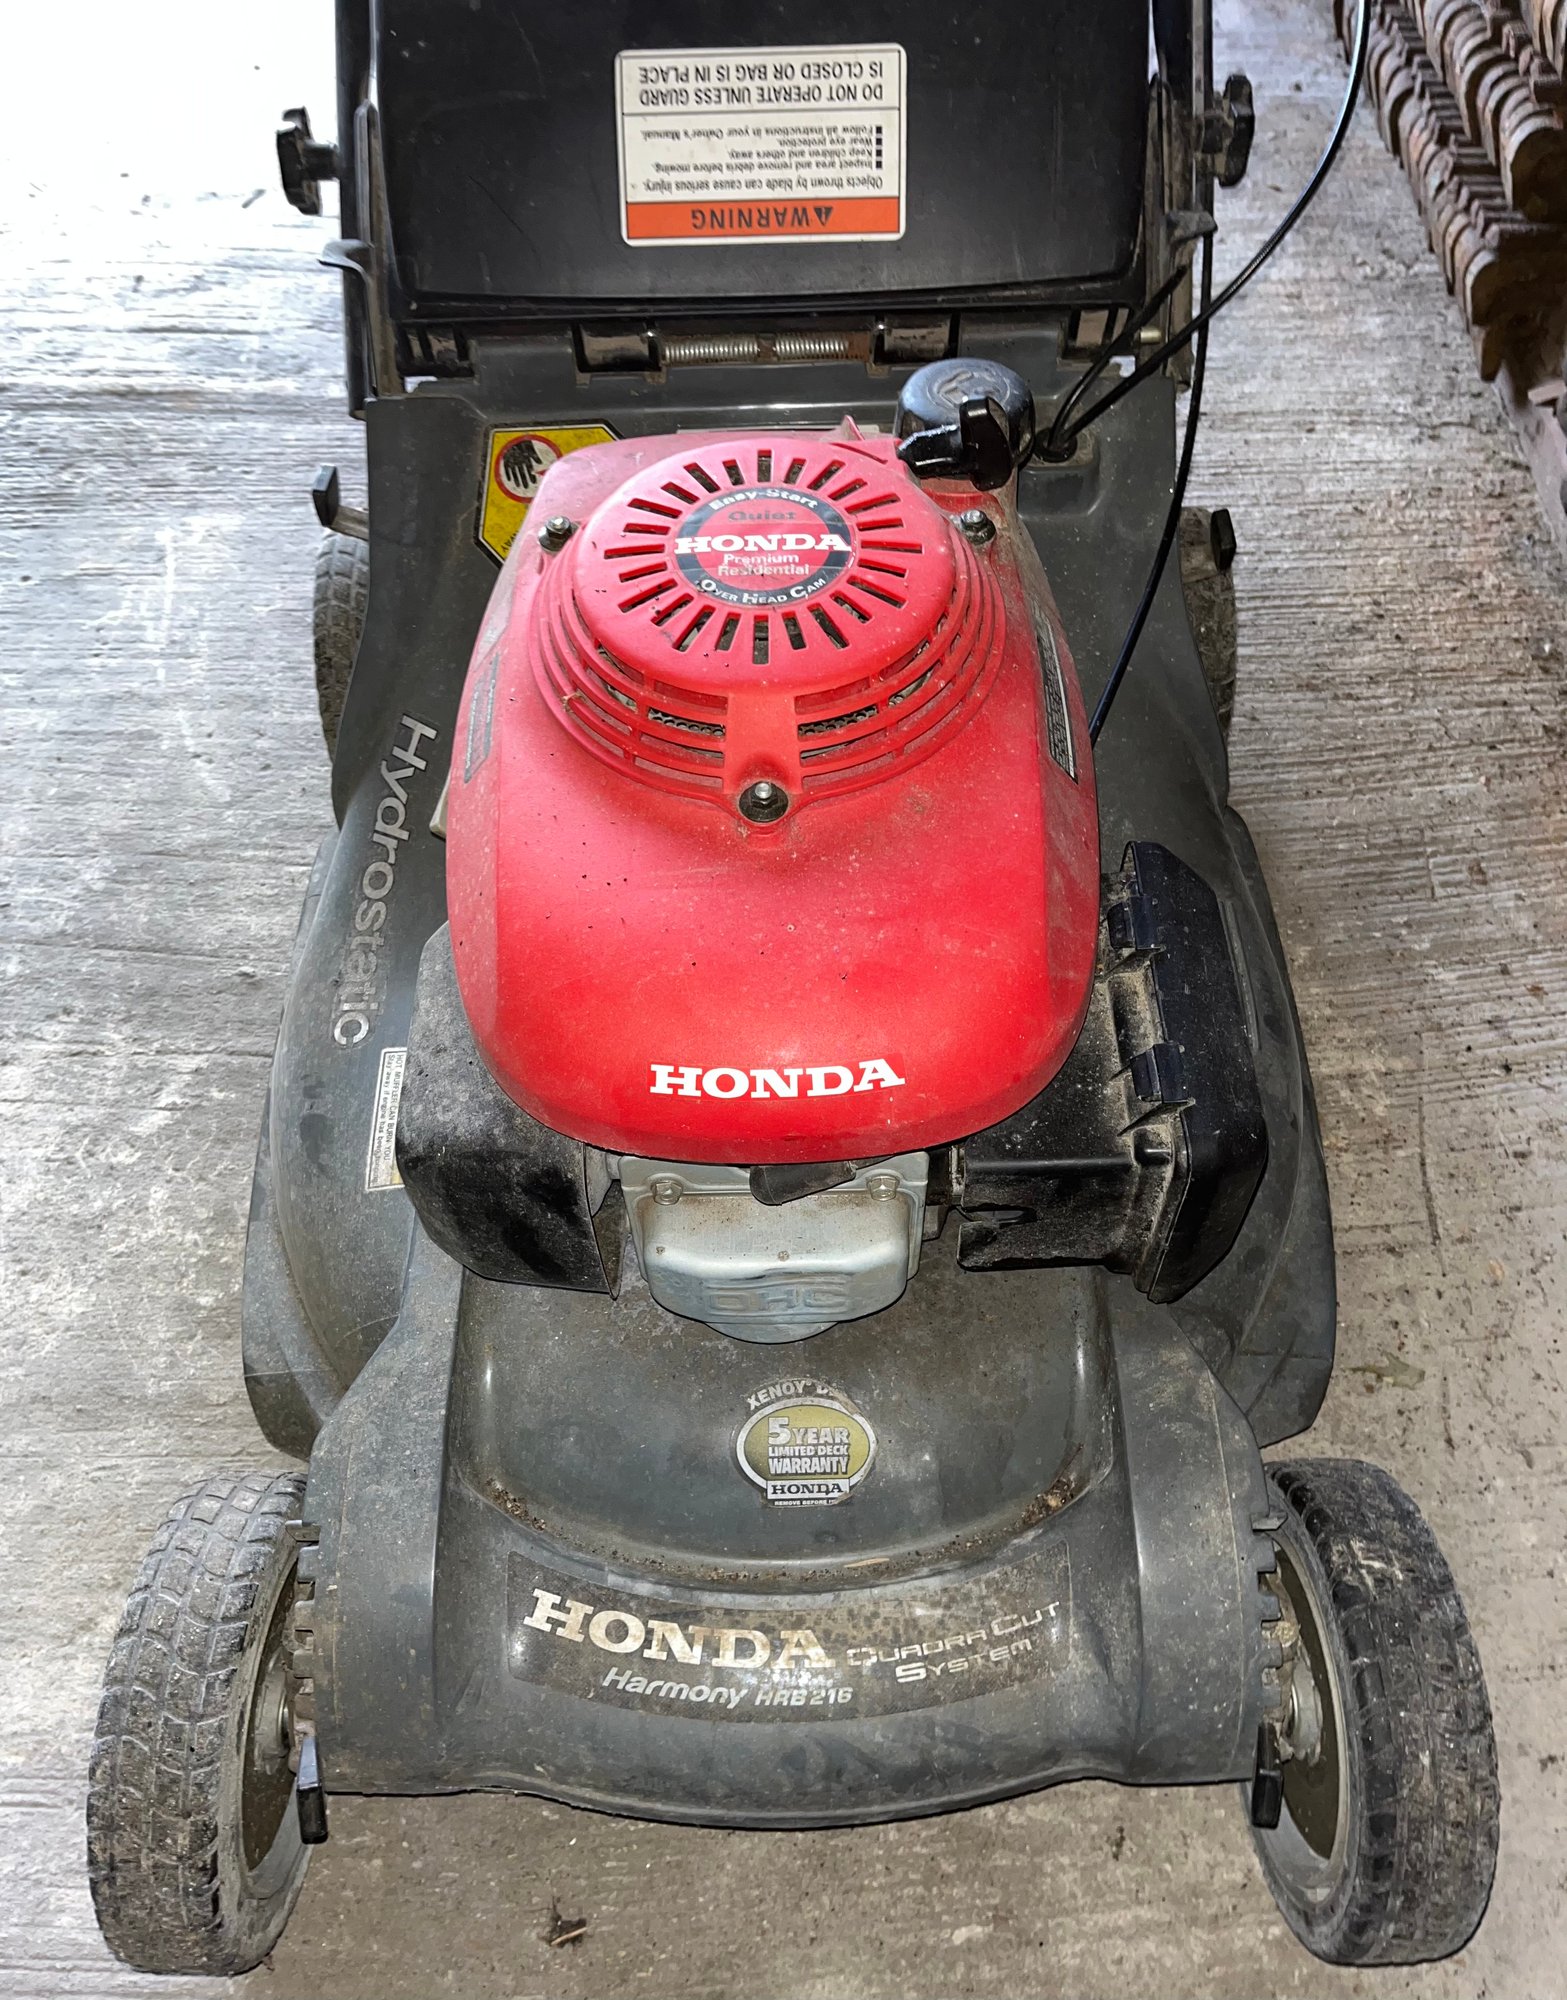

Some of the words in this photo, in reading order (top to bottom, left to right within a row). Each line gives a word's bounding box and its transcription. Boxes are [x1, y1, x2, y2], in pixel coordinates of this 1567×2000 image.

[638, 66, 689, 84] PLACE
[695, 66, 711, 82] IN
[716, 66, 730, 82] IS
[734, 64, 767, 81] BAG
[773, 62, 795, 81] OR
[801, 61, 863, 80] CLOSED
[869, 60, 883, 77] IS
[639, 89, 690, 106] GUARD
[694, 87, 751, 105] UNLESS
[756, 86, 822, 103] OPERATE
[827, 84, 857, 101] NOT
[862, 83, 883, 100] DO
[683, 128, 724, 140] Owner's
[727, 125, 750, 138] your
[751, 127, 762, 138] in
[765, 126, 824, 137] instructions
[825, 126, 839, 136] all
[840, 126, 873, 136] Follow
[777, 137, 828, 147] protection.
[829, 138, 847, 147] eye
[849, 138, 873, 147] Wear
[756, 151, 785, 161] others
[788, 150, 806, 160] and
[808, 149, 846, 159] children
[848, 149, 873, 159] Keep
[693, 163, 723, 174] before
[725, 162, 755, 172] debris
[757, 161, 793, 171] remove
[795, 160, 812, 170] and
[815, 160, 837, 170] area
[839, 160, 873, 171] Inspect
[643, 179, 673, 194] injury.
[675, 180, 710, 192] serious
[713, 179, 742, 190] cause
[745, 179, 763, 189] can
[766, 177, 793, 191] blade
[795, 177, 808, 191] by
[811, 177, 843, 190] thrown
[846, 176, 883, 190] Objects
[691, 207, 810, 229] WARNING
[708, 488, 819, 510] Easy-Start
[727, 510, 797, 521] Quiet
[674, 533, 852, 554] HONDA
[723, 553, 799, 568] Premium
[717, 563, 810, 577] Residential
[789, 577, 827, 600] CAM
[333, 714, 438, 1049] Hydrostatic
[395, 1054, 404, 1069] HOT
[650, 1058, 905, 1099] HONDA
[390, 1071, 401, 1104] MUFFLER
[388, 1105, 398, 1121] CAN
[386, 1122, 396, 1144] BURN
[708, 1286, 848, 1312] OHC
[767, 1416, 792, 1445] 5
[792, 1427, 850, 1445] YEAR
[768, 1445, 816, 1457] LIMITED
[817, 1445, 849, 1456] DECK
[768, 1457, 849, 1474] WARRANTY
[771, 1483, 844, 1496] HONDA
[523, 1588, 835, 1669] HONDA
[895, 1638, 1032, 1683] SYSTEM
[602, 1666, 749, 1709] Harmony
